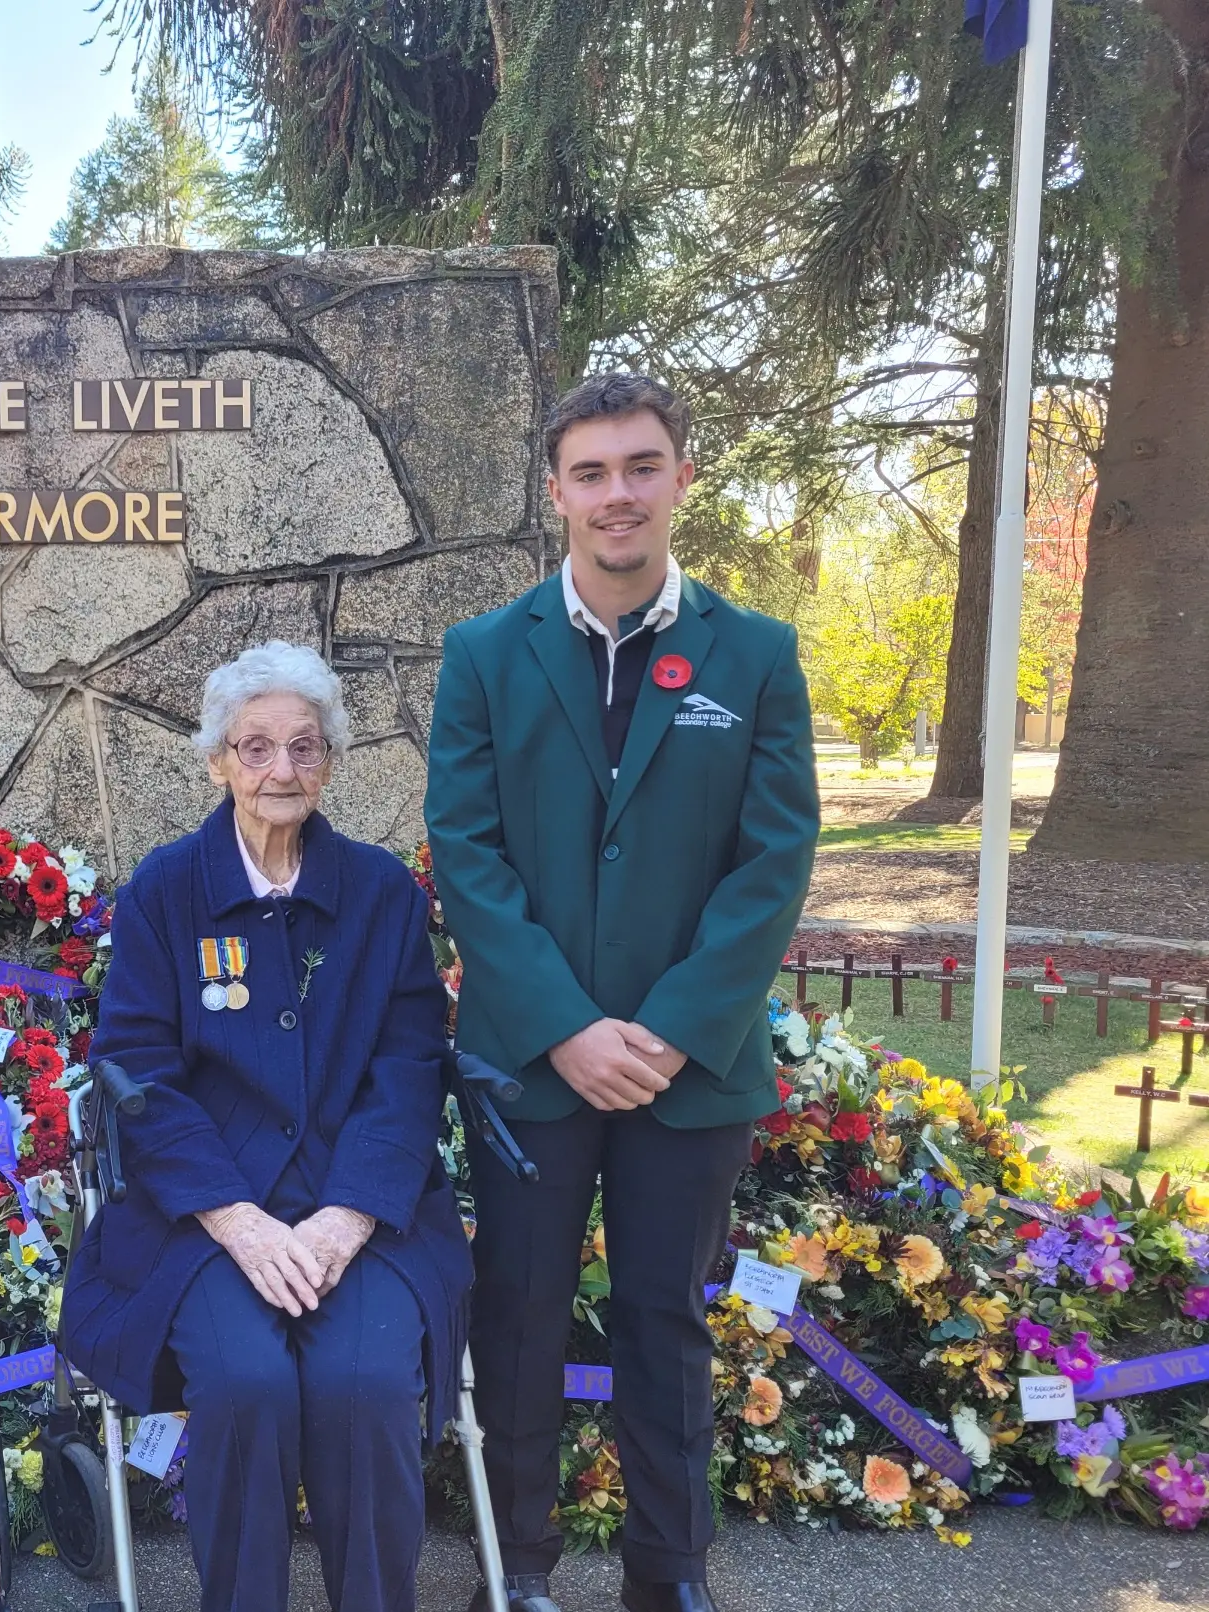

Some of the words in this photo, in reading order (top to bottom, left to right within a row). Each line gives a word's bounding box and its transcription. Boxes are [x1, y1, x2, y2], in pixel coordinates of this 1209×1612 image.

[74, 379, 251, 429] LIVETH
[674, 712, 732, 722] BEECHWORTH
[674, 719, 708, 727] secondary
[709, 720, 732, 728] college
[4, 968, 76, 998] FORGET
[564, 1369, 577, 1392] E
[1161, 1355, 1205, 1379] WE
[786, 1310, 840, 1364] LEST
[839, 1357, 879, 1400] WE
[873, 1394, 965, 1472] FORGET
[137, 1419, 158, 1460] BEECHWORTH
[145, 1442, 159, 1463] LIONS
[155, 1423, 167, 1442] CLUB
